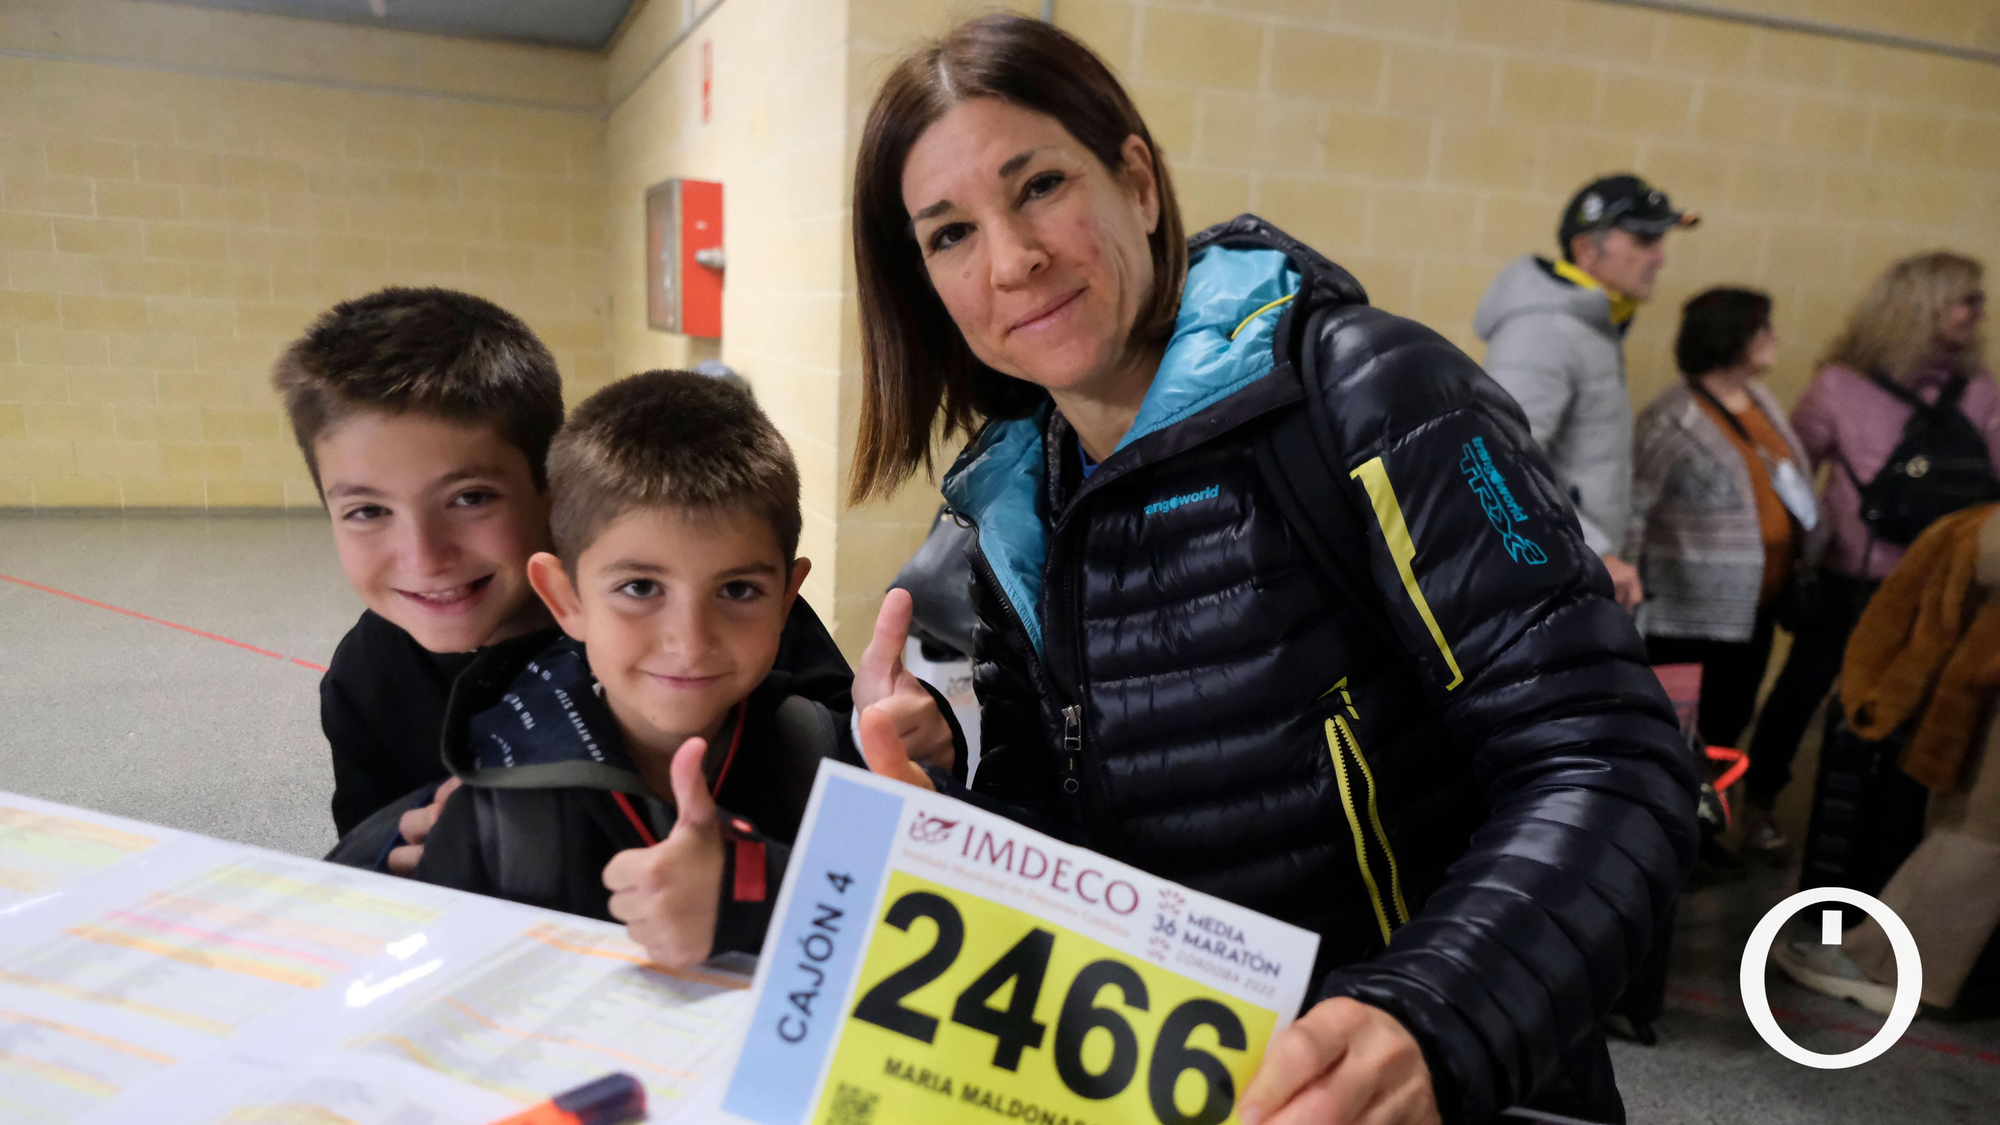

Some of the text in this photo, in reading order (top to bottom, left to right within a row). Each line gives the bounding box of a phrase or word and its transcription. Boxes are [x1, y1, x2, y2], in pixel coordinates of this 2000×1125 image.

[568, 711, 592, 742] NEVER
[961, 824, 1140, 916] IMDECO
[776, 870, 855, 1044] CAJÓN 4
[1152, 913, 1282, 979] 36 MARATÓN
[1187, 912, 1245, 944] MEDIA
[852, 890, 1248, 1125] 2466
[883, 1057, 954, 1096] MARIA
